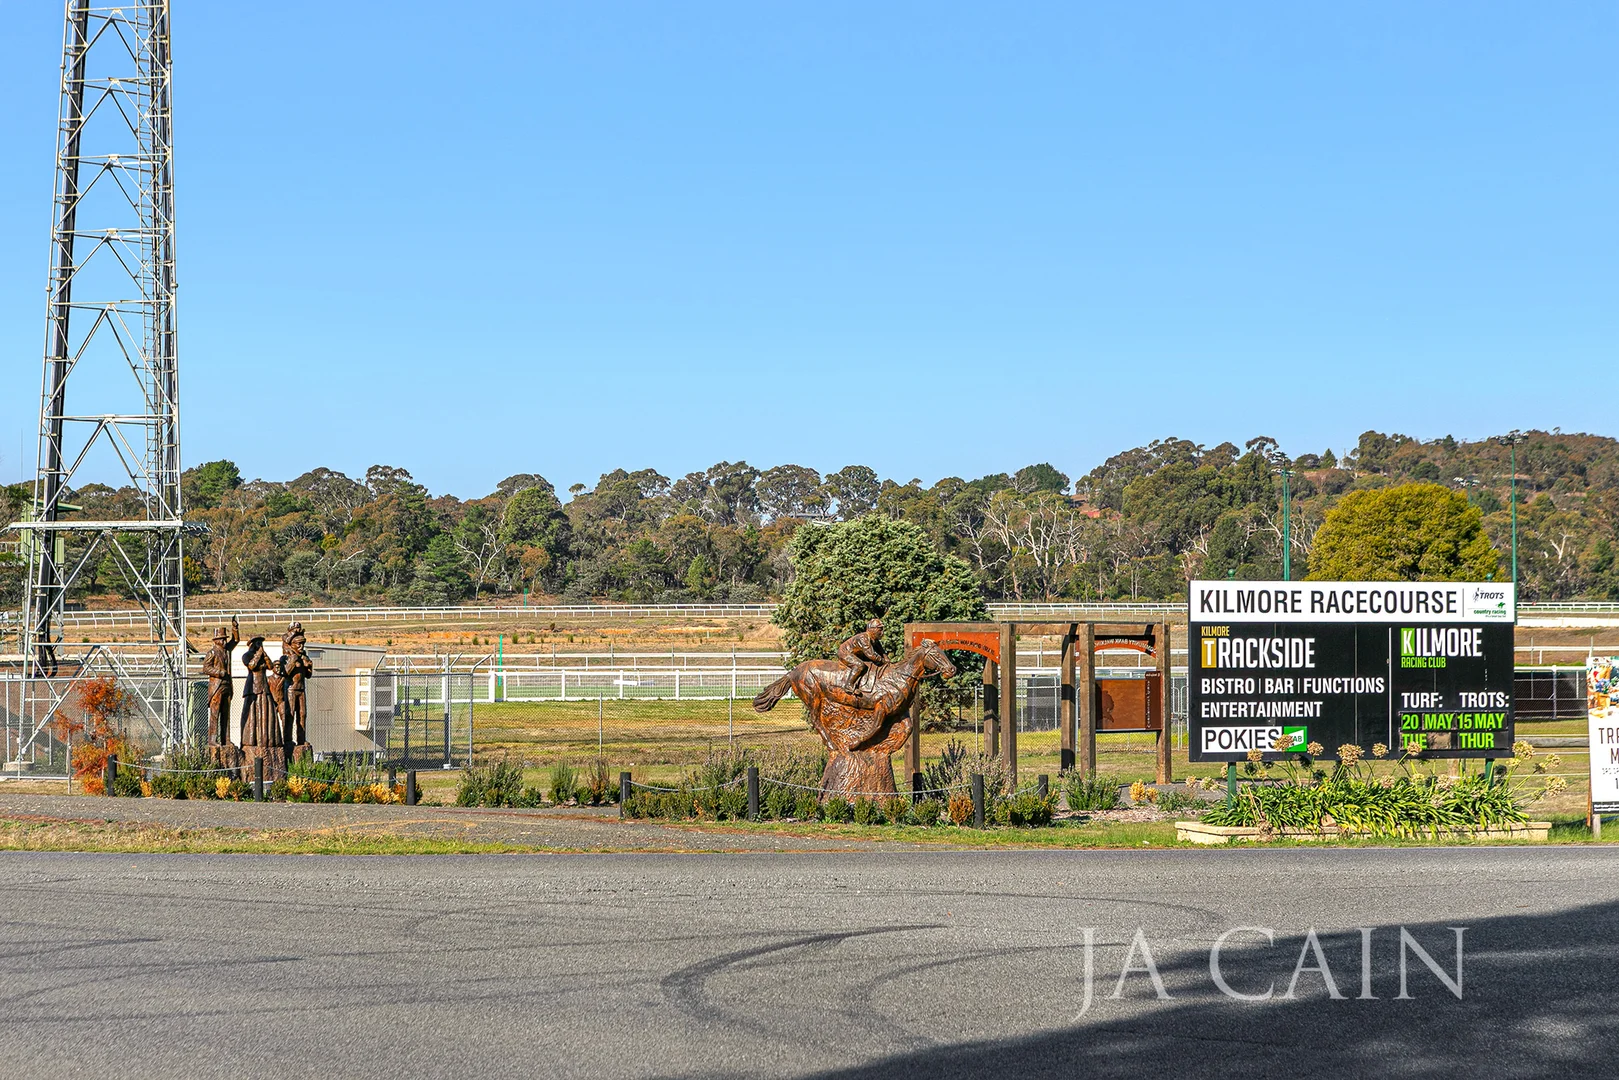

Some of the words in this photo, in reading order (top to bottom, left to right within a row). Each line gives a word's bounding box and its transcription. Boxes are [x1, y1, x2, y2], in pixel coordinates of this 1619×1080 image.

[1200, 589, 1302, 614] KILMORE
[1310, 589, 1457, 614] RACECOURSE
[1480, 592, 1504, 600] TROTS
[1201, 626, 1230, 636] KILMORE
[1402, 628, 1483, 657] KILMORE
[1202, 637, 1316, 669] TRACKSIDE
[1401, 657, 1427, 668] RACING
[1428, 657, 1446, 668] CLUB
[1201, 678, 1255, 695] BISTRO
[1265, 677, 1294, 694] BAR
[1303, 677, 1385, 694] FUNCTIONS
[1401, 692, 1443, 708] TURF:
[1459, 692, 1509, 708] TROTS:
[1201, 701, 1323, 718] ENTERTAINMENT
[1402, 714, 1419, 730] 20
[1424, 713, 1454, 730] MAY
[1457, 714, 1472, 729] 15
[1474, 713, 1505, 729] MAY
[1205, 729, 1280, 750] POKIES
[1291, 734, 1303, 743] AB
[1401, 733, 1428, 748] TUE
[1459, 733, 1494, 749] THUR
